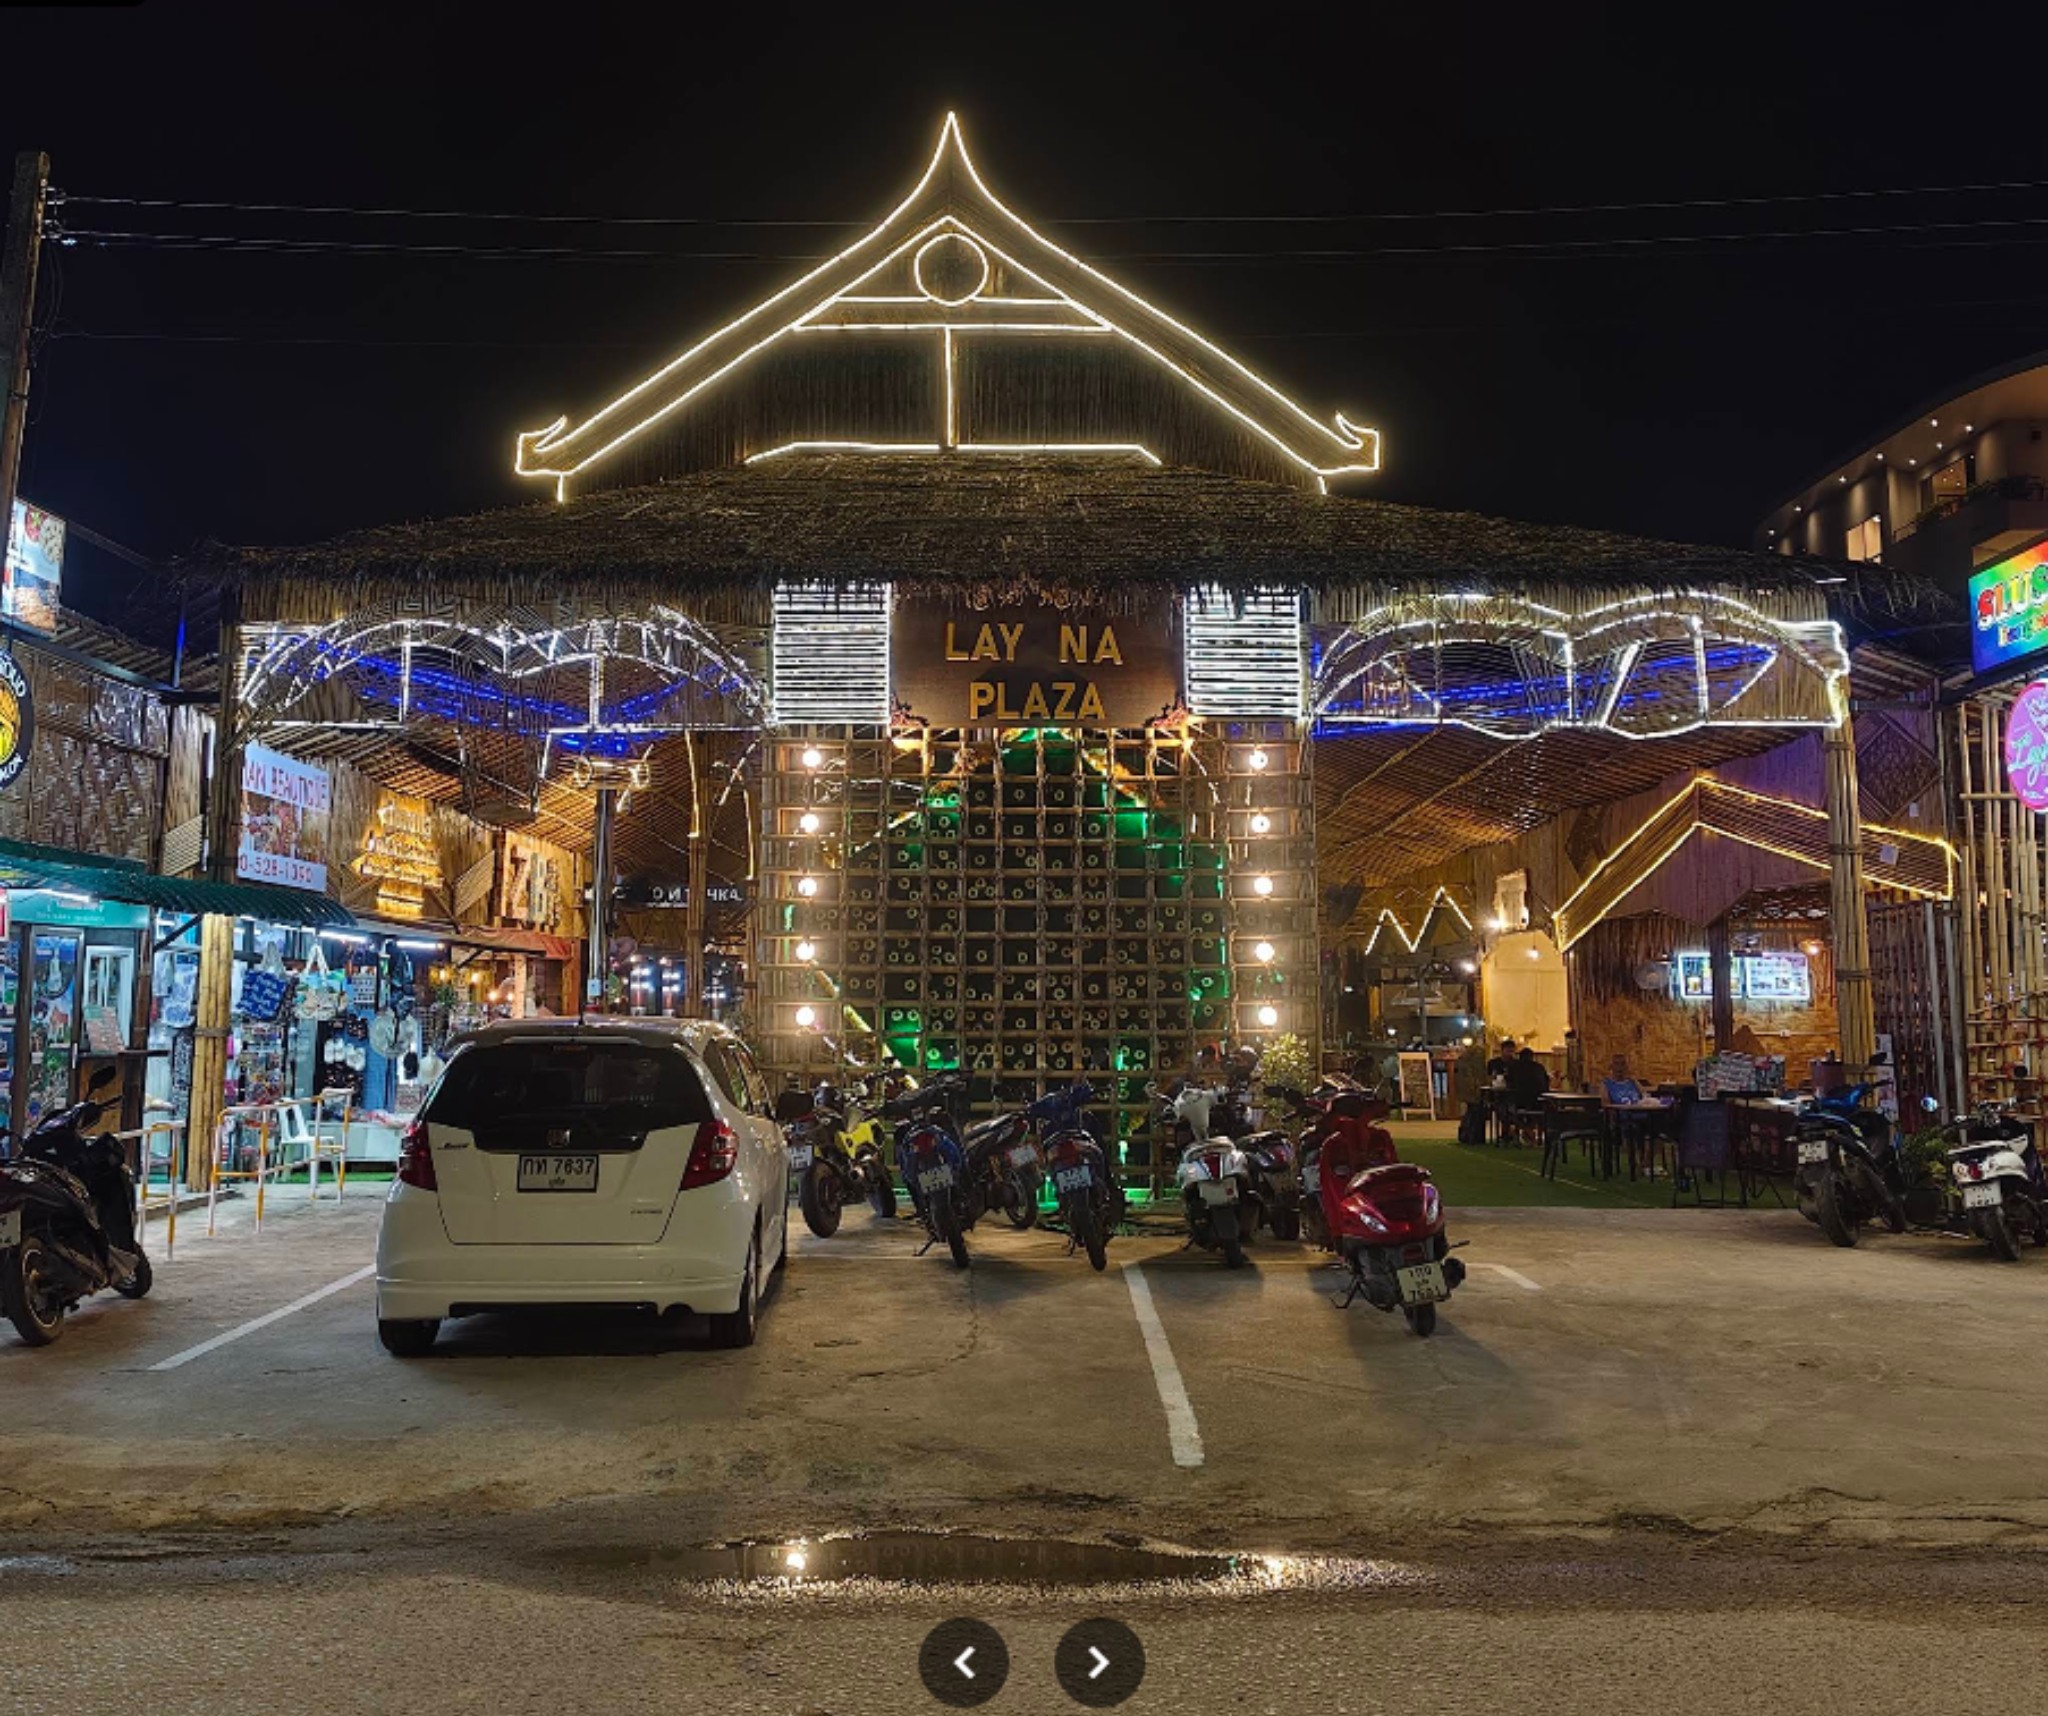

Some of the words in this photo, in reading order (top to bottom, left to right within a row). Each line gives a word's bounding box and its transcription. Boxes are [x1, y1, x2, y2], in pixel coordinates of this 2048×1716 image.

[945, 622, 1025, 663] LAY
[1058, 624, 1124, 665] NA
[969, 681, 1106, 721] PLAZA
[553, 1158, 595, 1175] 7637
